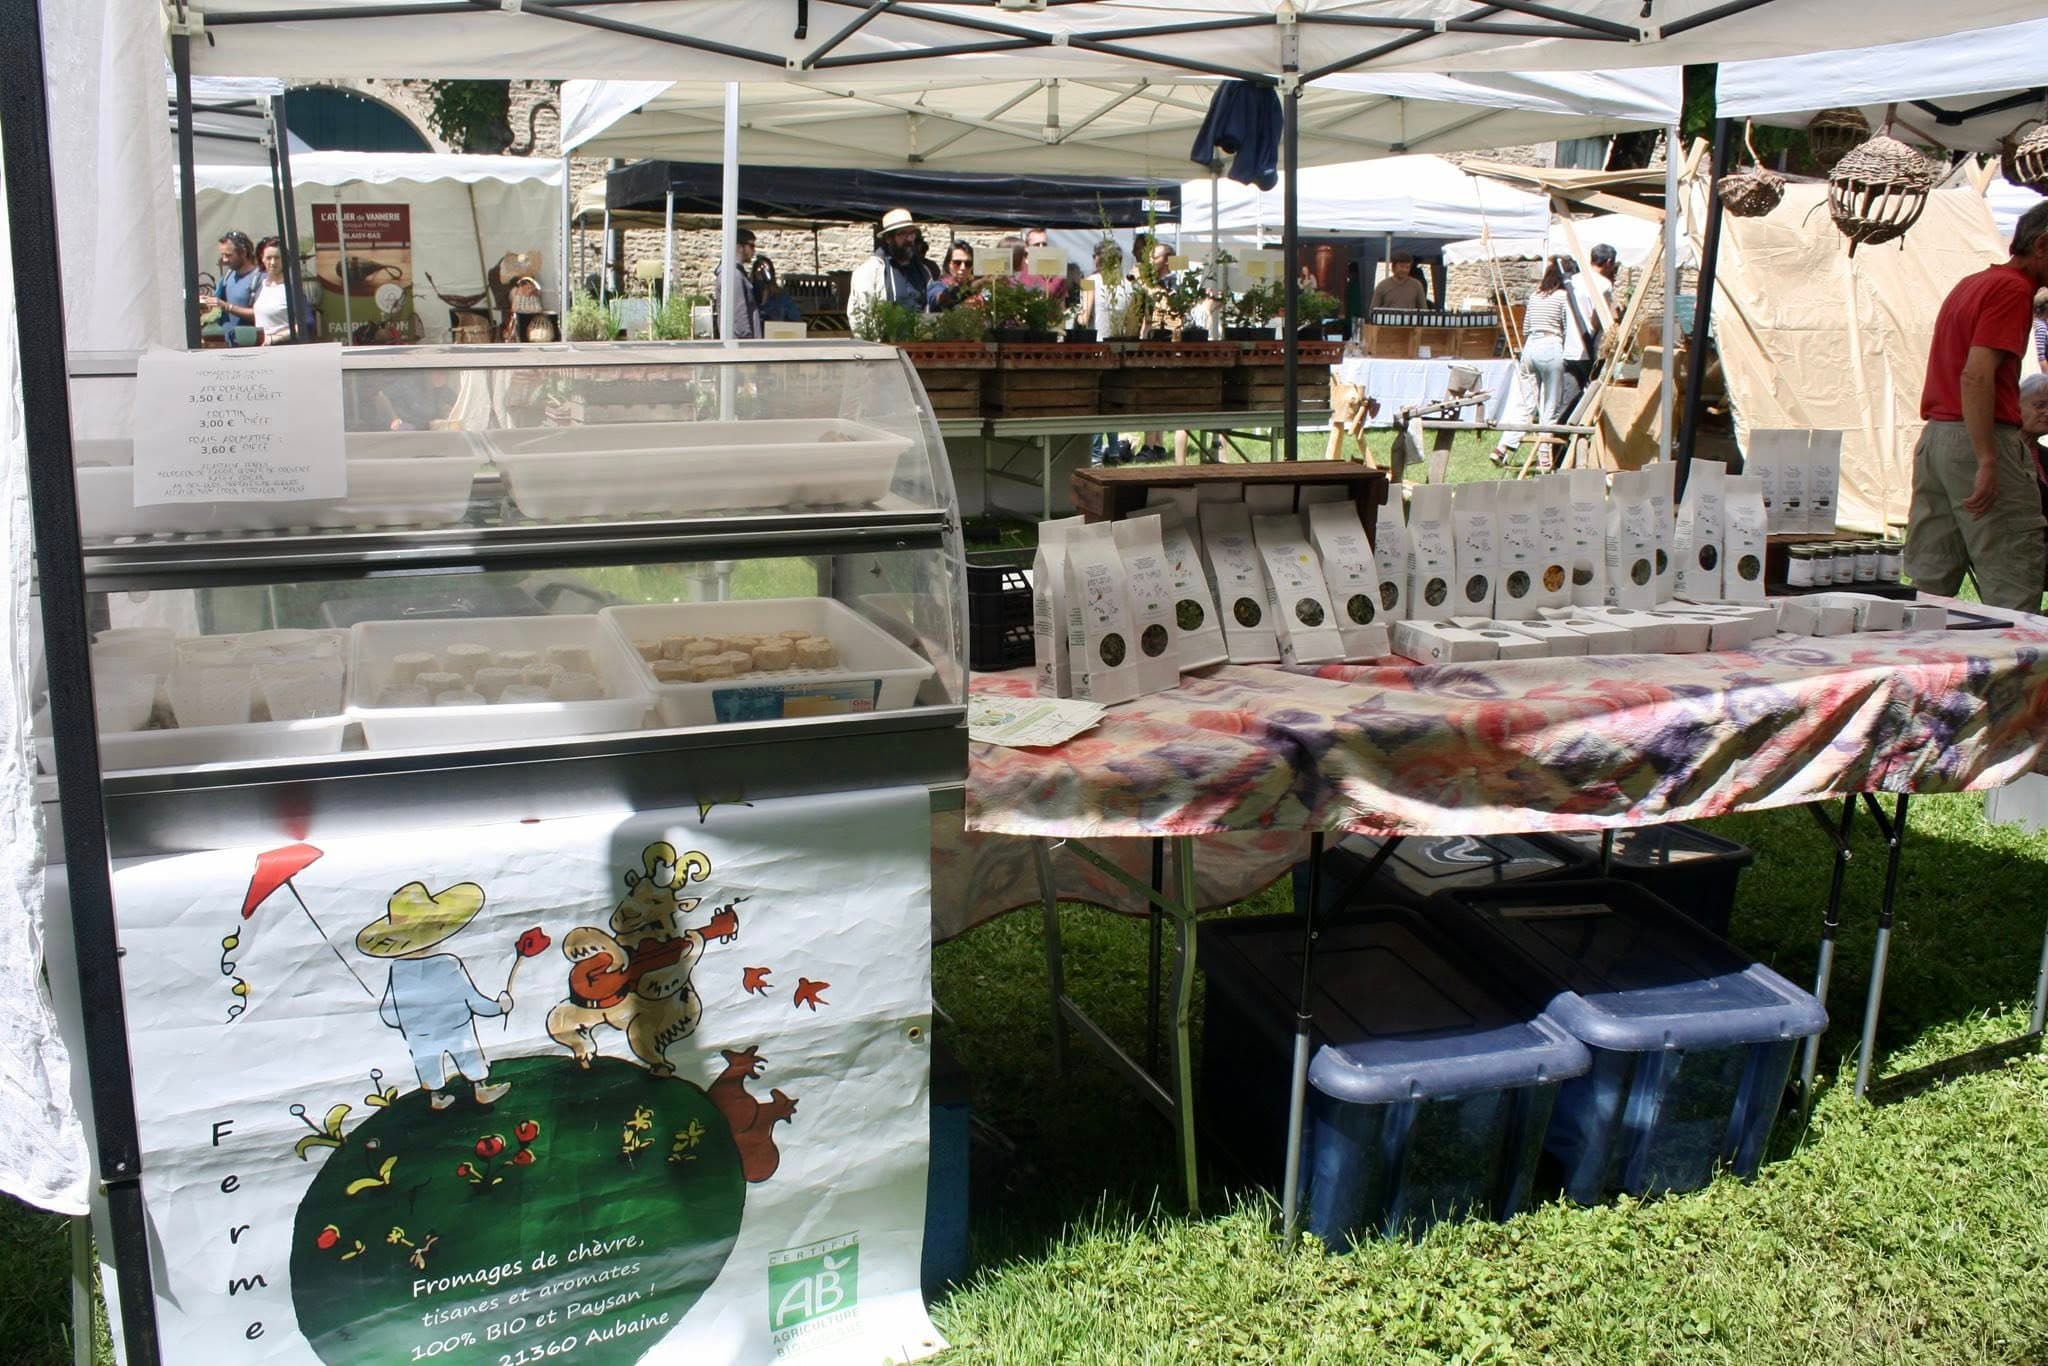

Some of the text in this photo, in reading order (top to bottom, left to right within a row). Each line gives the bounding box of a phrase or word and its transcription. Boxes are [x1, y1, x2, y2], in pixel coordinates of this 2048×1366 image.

[365, 212, 400, 222] VANNERIE
[189, 394, 214, 403] 3,50
[216, 394, 224, 402] €
[199, 419, 224, 429] 3,00
[227, 419, 235, 428] €
[201, 446, 226, 455] 3,60
[229, 444, 237, 453] €
[412, 1234, 645, 1299] Fromages de chèvre,
[421, 1262, 641, 1328] tisanes et aromates
[775, 1270, 844, 1327] AB
[411, 1331, 477, 1362] 100%
[486, 1316, 527, 1341] BIO
[535, 1308, 558, 1328] et
[566, 1289, 642, 1320] Paysan
[498, 1311, 670, 1366] 21360 Aubaine
[772, 1308, 860, 1345] AGRICULTURE
